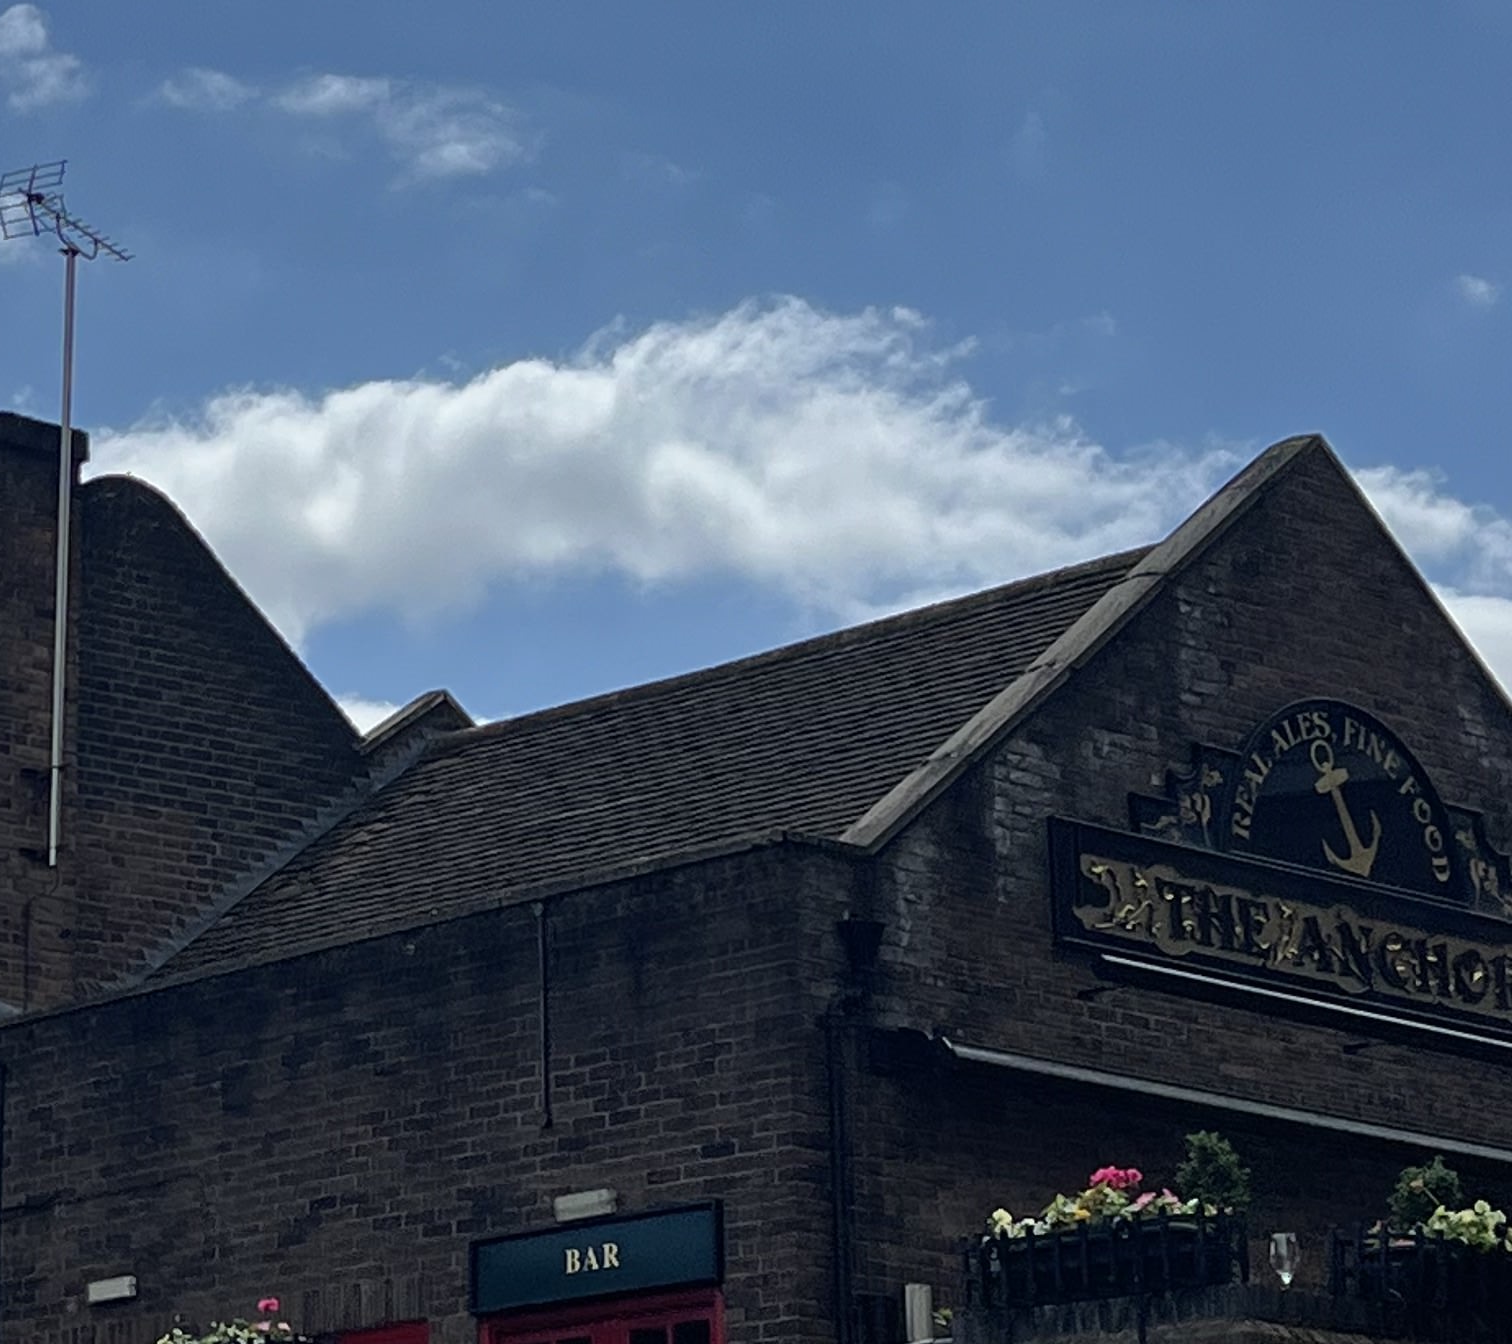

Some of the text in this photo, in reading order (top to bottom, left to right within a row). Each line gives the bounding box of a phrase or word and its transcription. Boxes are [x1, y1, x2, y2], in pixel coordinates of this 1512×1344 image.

[1231, 752, 1273, 840] REAL
[1343, 717, 1400, 780] FINE
[1399, 776, 1451, 883] FOOD
[1155, 876, 1270, 953] THE
[564, 1242, 620, 1275] BAR
